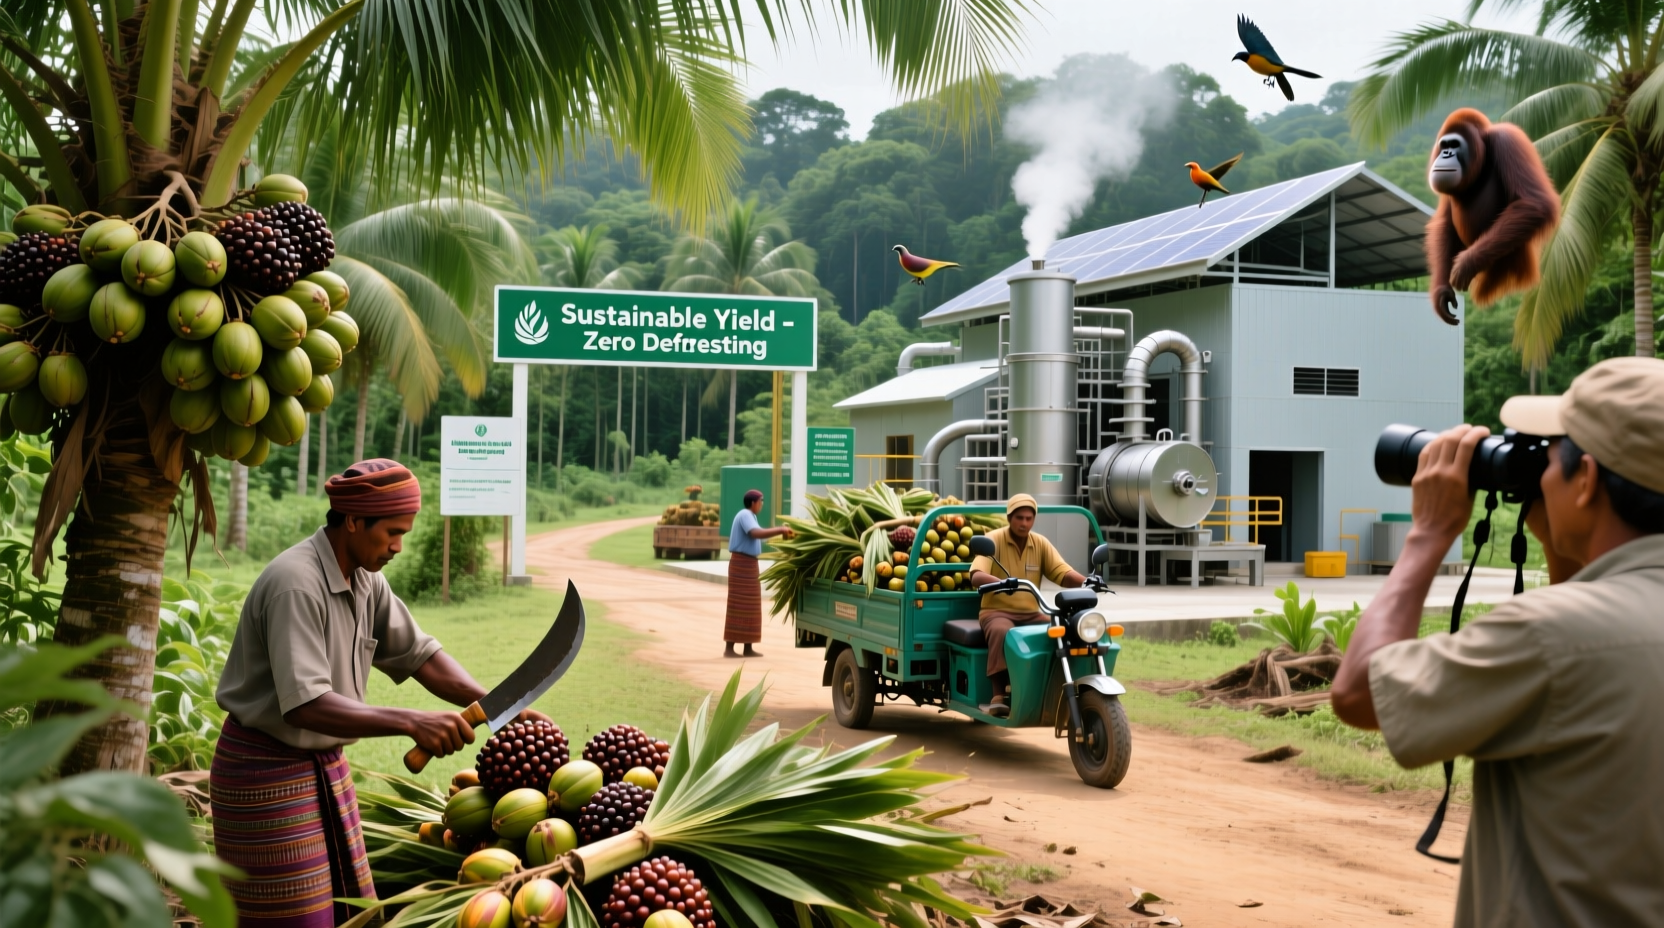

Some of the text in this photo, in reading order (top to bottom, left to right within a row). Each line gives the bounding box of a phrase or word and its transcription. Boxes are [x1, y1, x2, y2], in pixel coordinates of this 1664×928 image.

[561, 303, 707, 329] Sustainable
[713, 308, 775, 332] Yield
[582, 330, 636, 352] Zero
